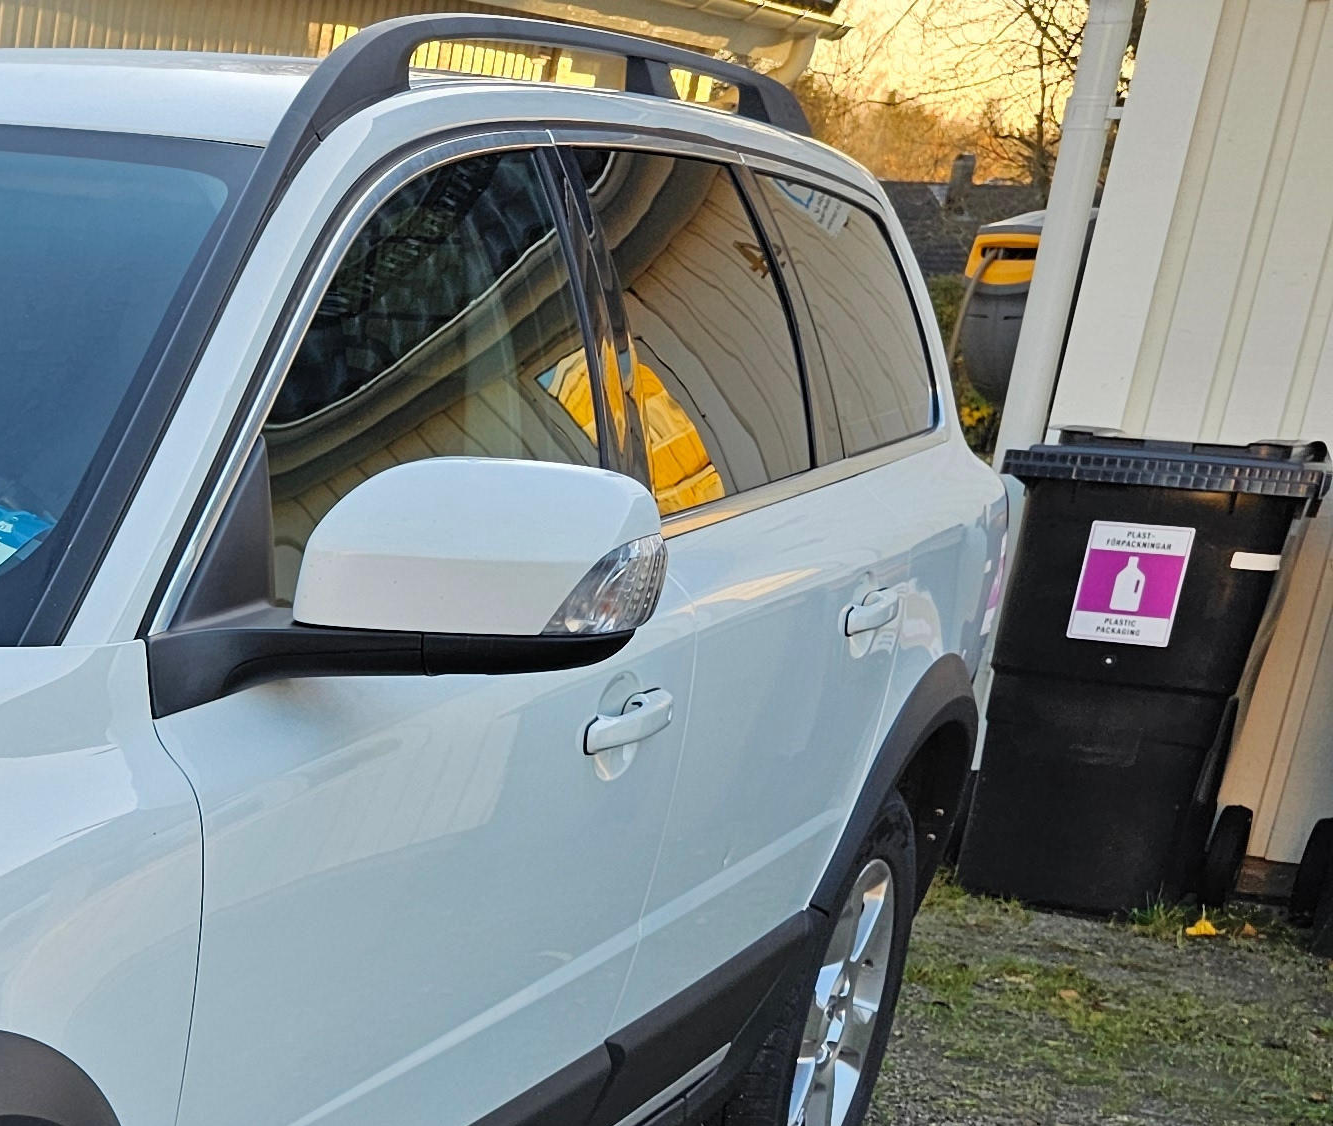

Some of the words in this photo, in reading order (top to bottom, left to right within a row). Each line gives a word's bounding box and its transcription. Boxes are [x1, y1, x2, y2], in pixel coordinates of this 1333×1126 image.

[1126, 530, 1156, 540] PLAST-
[1106, 538, 1172, 550] FÖRPACKNINGAR
[1104, 617, 1137, 627] PLASTIC
[1095, 625, 1141, 636] PACKAGING
